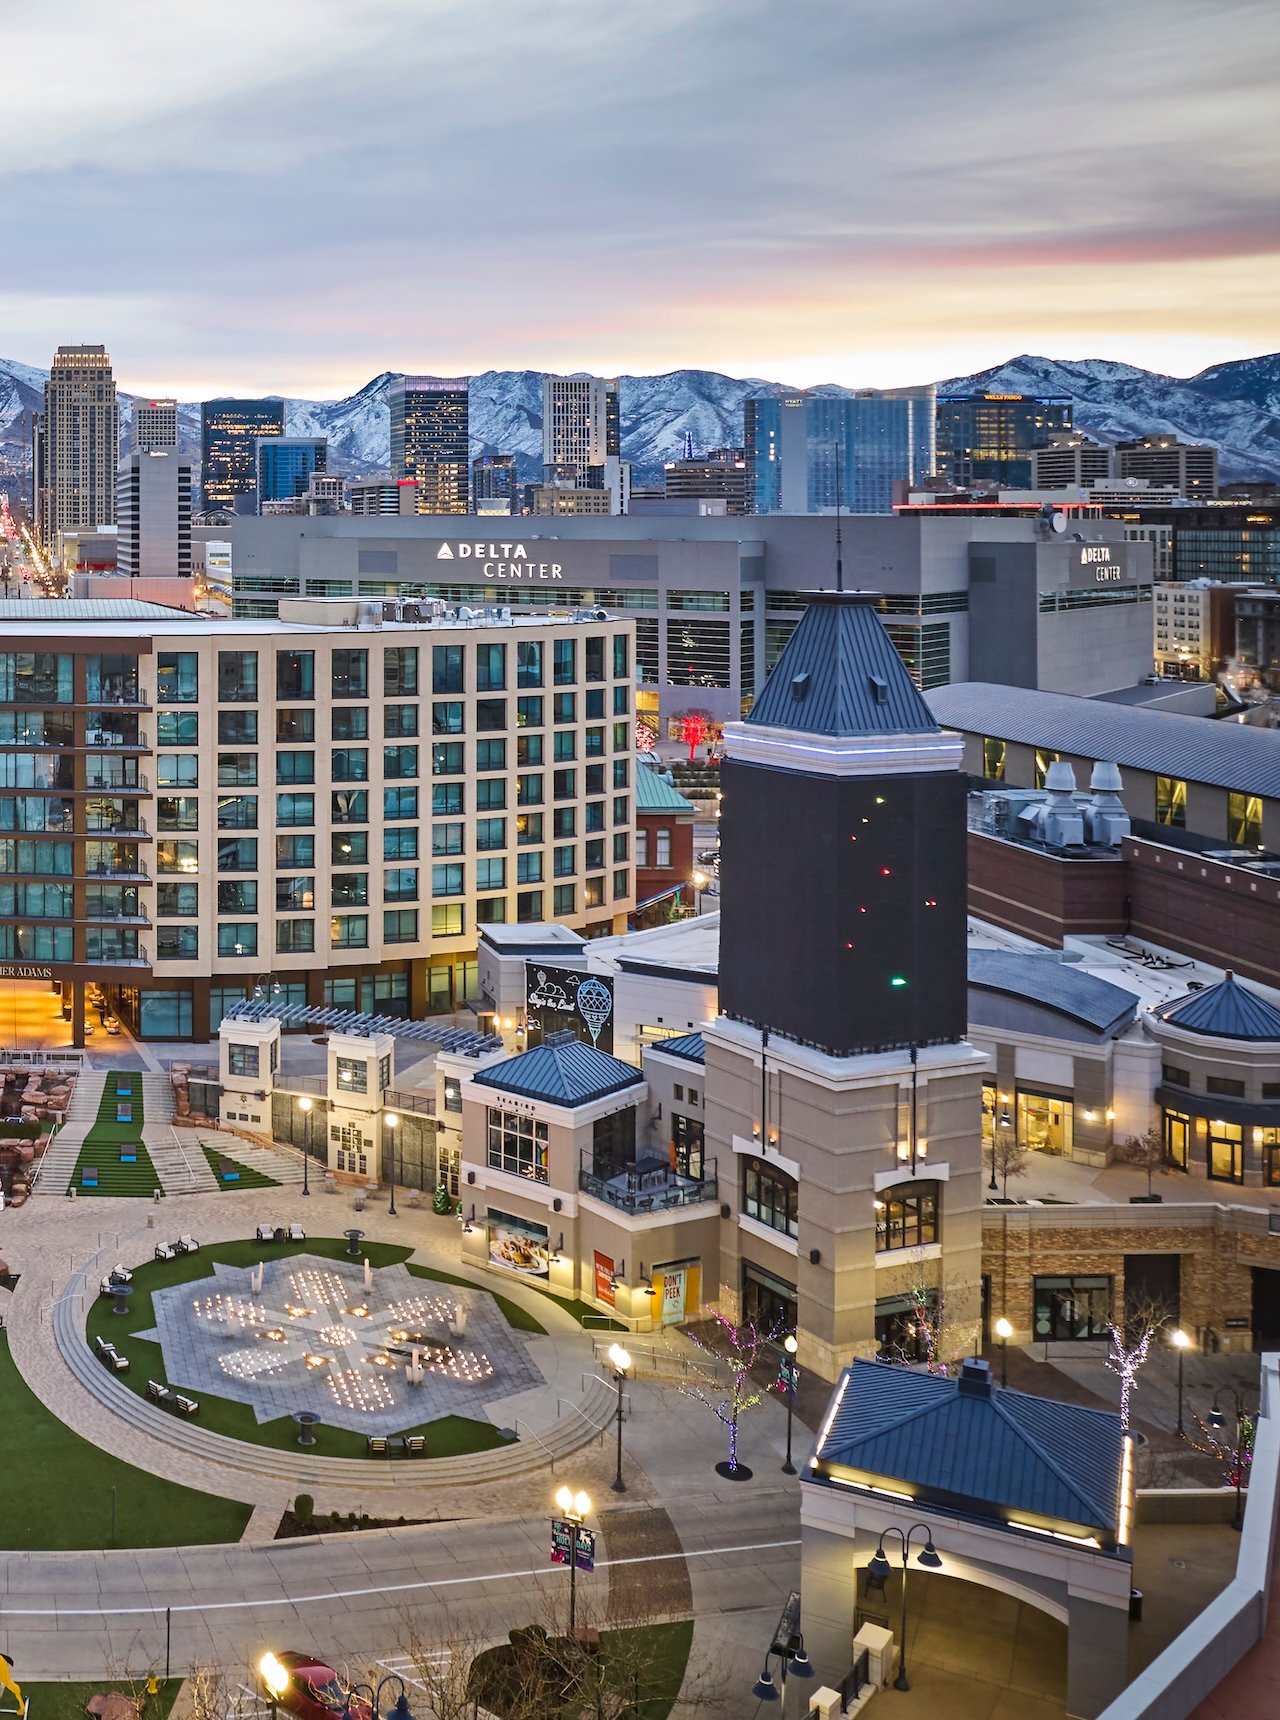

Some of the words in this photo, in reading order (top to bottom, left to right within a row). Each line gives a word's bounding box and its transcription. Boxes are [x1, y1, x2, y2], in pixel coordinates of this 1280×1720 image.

[458, 543, 528, 559] DELTA
[1087, 547, 1110, 562] DELTA
[483, 562, 563, 579] CENTER
[1096, 566, 1121, 582] CENTER
[16, 967, 52, 978] ADAMS
[496, 1096, 536, 1111] SEABIRD
[664, 1273, 682, 1288] DON'T
[665, 1287, 681, 1300] PEEK
